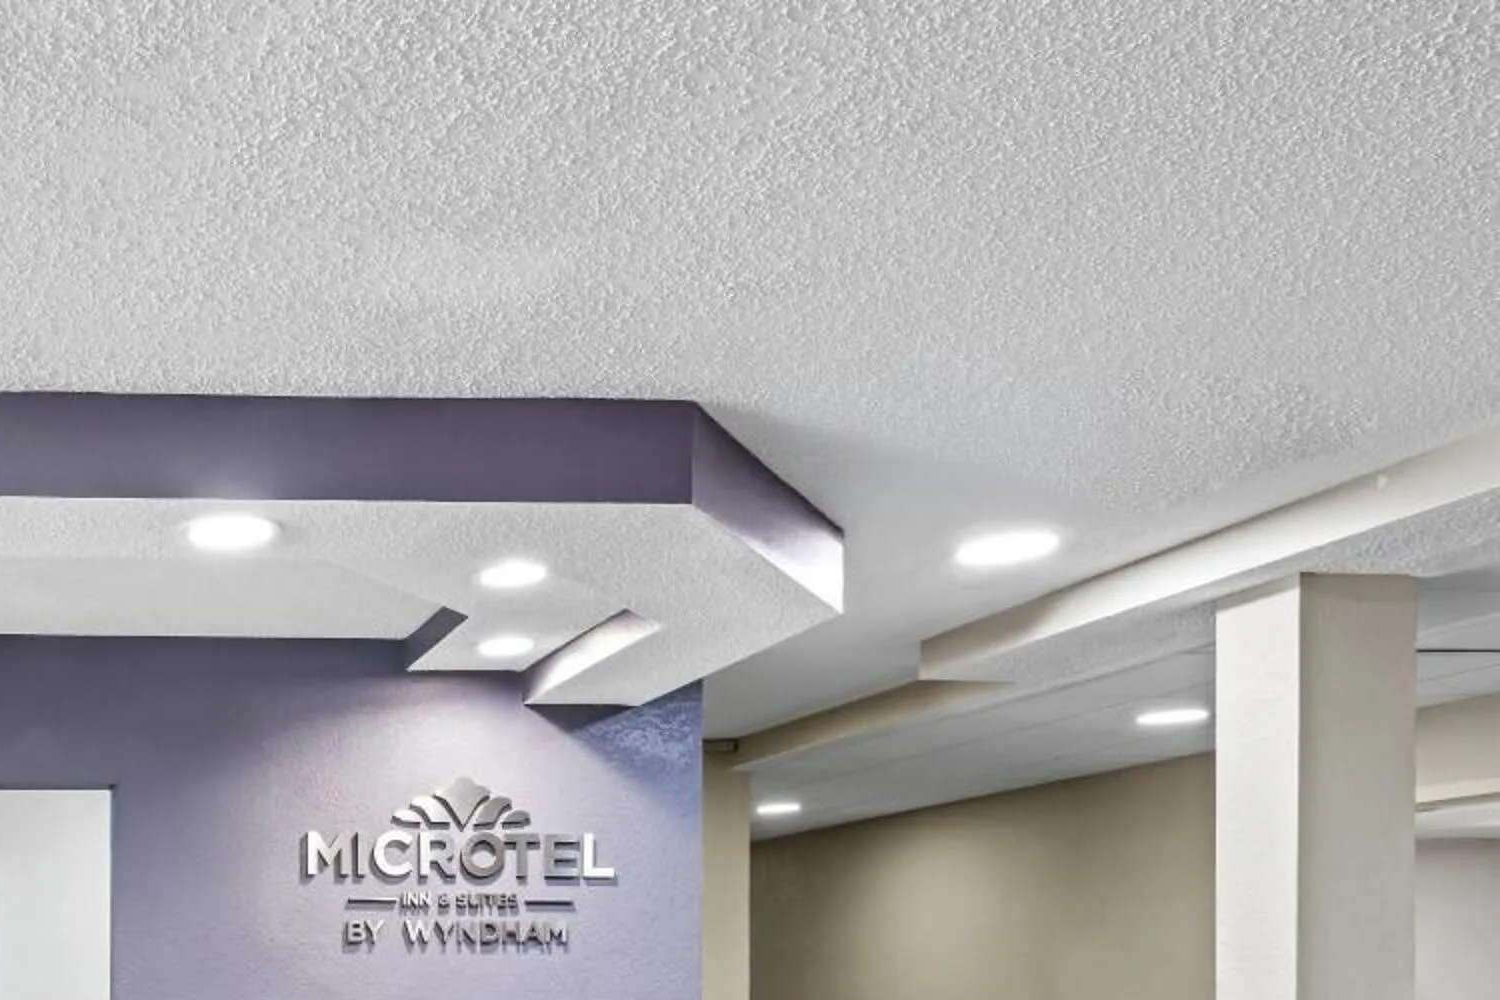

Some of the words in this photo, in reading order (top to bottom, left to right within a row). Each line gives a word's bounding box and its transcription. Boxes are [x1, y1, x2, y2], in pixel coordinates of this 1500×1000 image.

[304, 831, 615, 880] MICROTEL
[401, 891, 431, 909] INN
[437, 893, 450, 910] &
[455, 893, 519, 910] SUITES
[346, 919, 384, 946] BY
[403, 919, 568, 946] WYNDHAM
